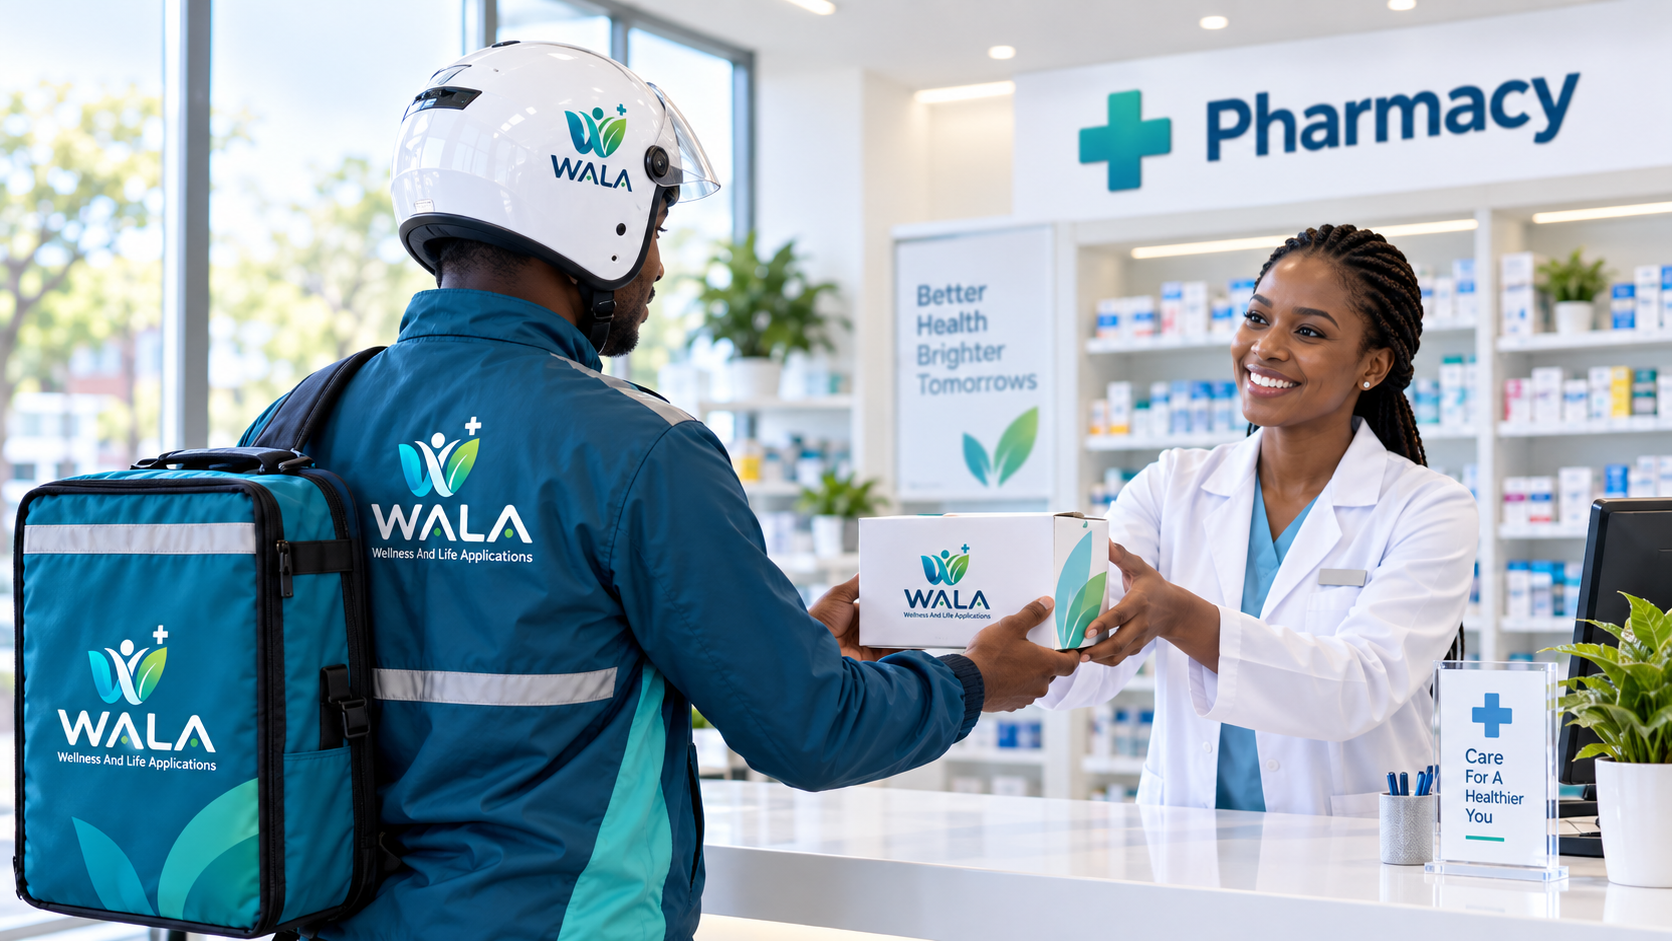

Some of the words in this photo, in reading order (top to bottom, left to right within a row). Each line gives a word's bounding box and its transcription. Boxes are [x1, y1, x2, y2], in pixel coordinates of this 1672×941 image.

[1206, 72, 1581, 163] Pharmacy
[550, 154, 633, 192] WALA
[916, 283, 987, 307] Better
[916, 310, 988, 336] Health
[916, 341, 1005, 370] Brighter
[916, 372, 1038, 396] Tomorrows
[371, 503, 533, 544] WALA
[372, 547, 414, 559] Wellness
[417, 548, 435, 560] And
[438, 548, 458, 560] Life
[460, 549, 533, 563] Applications
[904, 589, 990, 610] WALA
[954, 612, 991, 620] Applications
[57, 708, 217, 753] WALA
[57, 751, 101, 765] Wellness
[103, 753, 124, 766] And
[126, 755, 147, 767] Life
[148, 756, 217, 771] Applications
[1465, 748, 1504, 765] Care
[1465, 769, 1489, 784] For
[1492, 771, 1503, 785] A
[1465, 789, 1524, 805] Healthier
[1465, 808, 1493, 824] You
